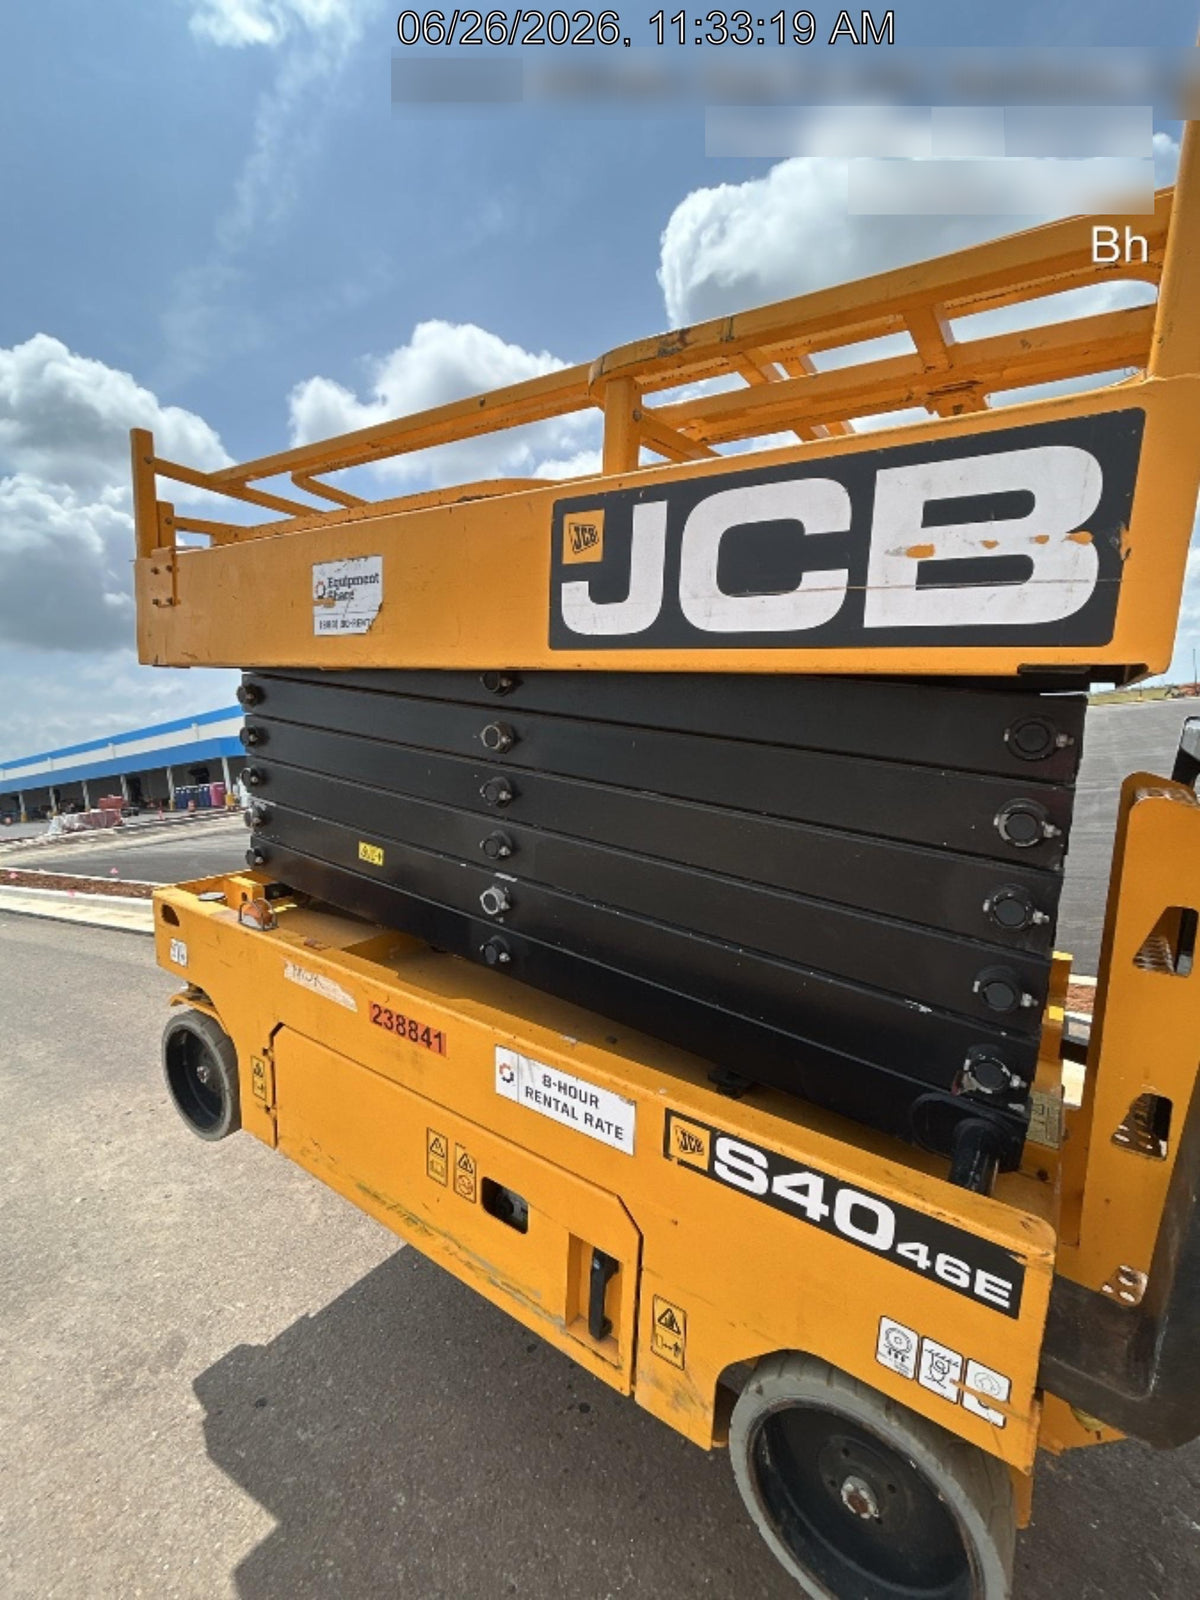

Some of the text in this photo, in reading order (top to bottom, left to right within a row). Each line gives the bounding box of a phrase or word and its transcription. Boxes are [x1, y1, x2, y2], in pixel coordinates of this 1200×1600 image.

[560, 445, 1104, 636] JCB
[572, 525, 597, 551] JCB
[327, 572, 380, 590] Equipment
[372, 1003, 442, 1054] 238841
[525, 1085, 624, 1141] RENTAL RATE
[542, 1074, 600, 1109] 8-HOUR
[713, 1136, 1013, 1309] S40 46E
